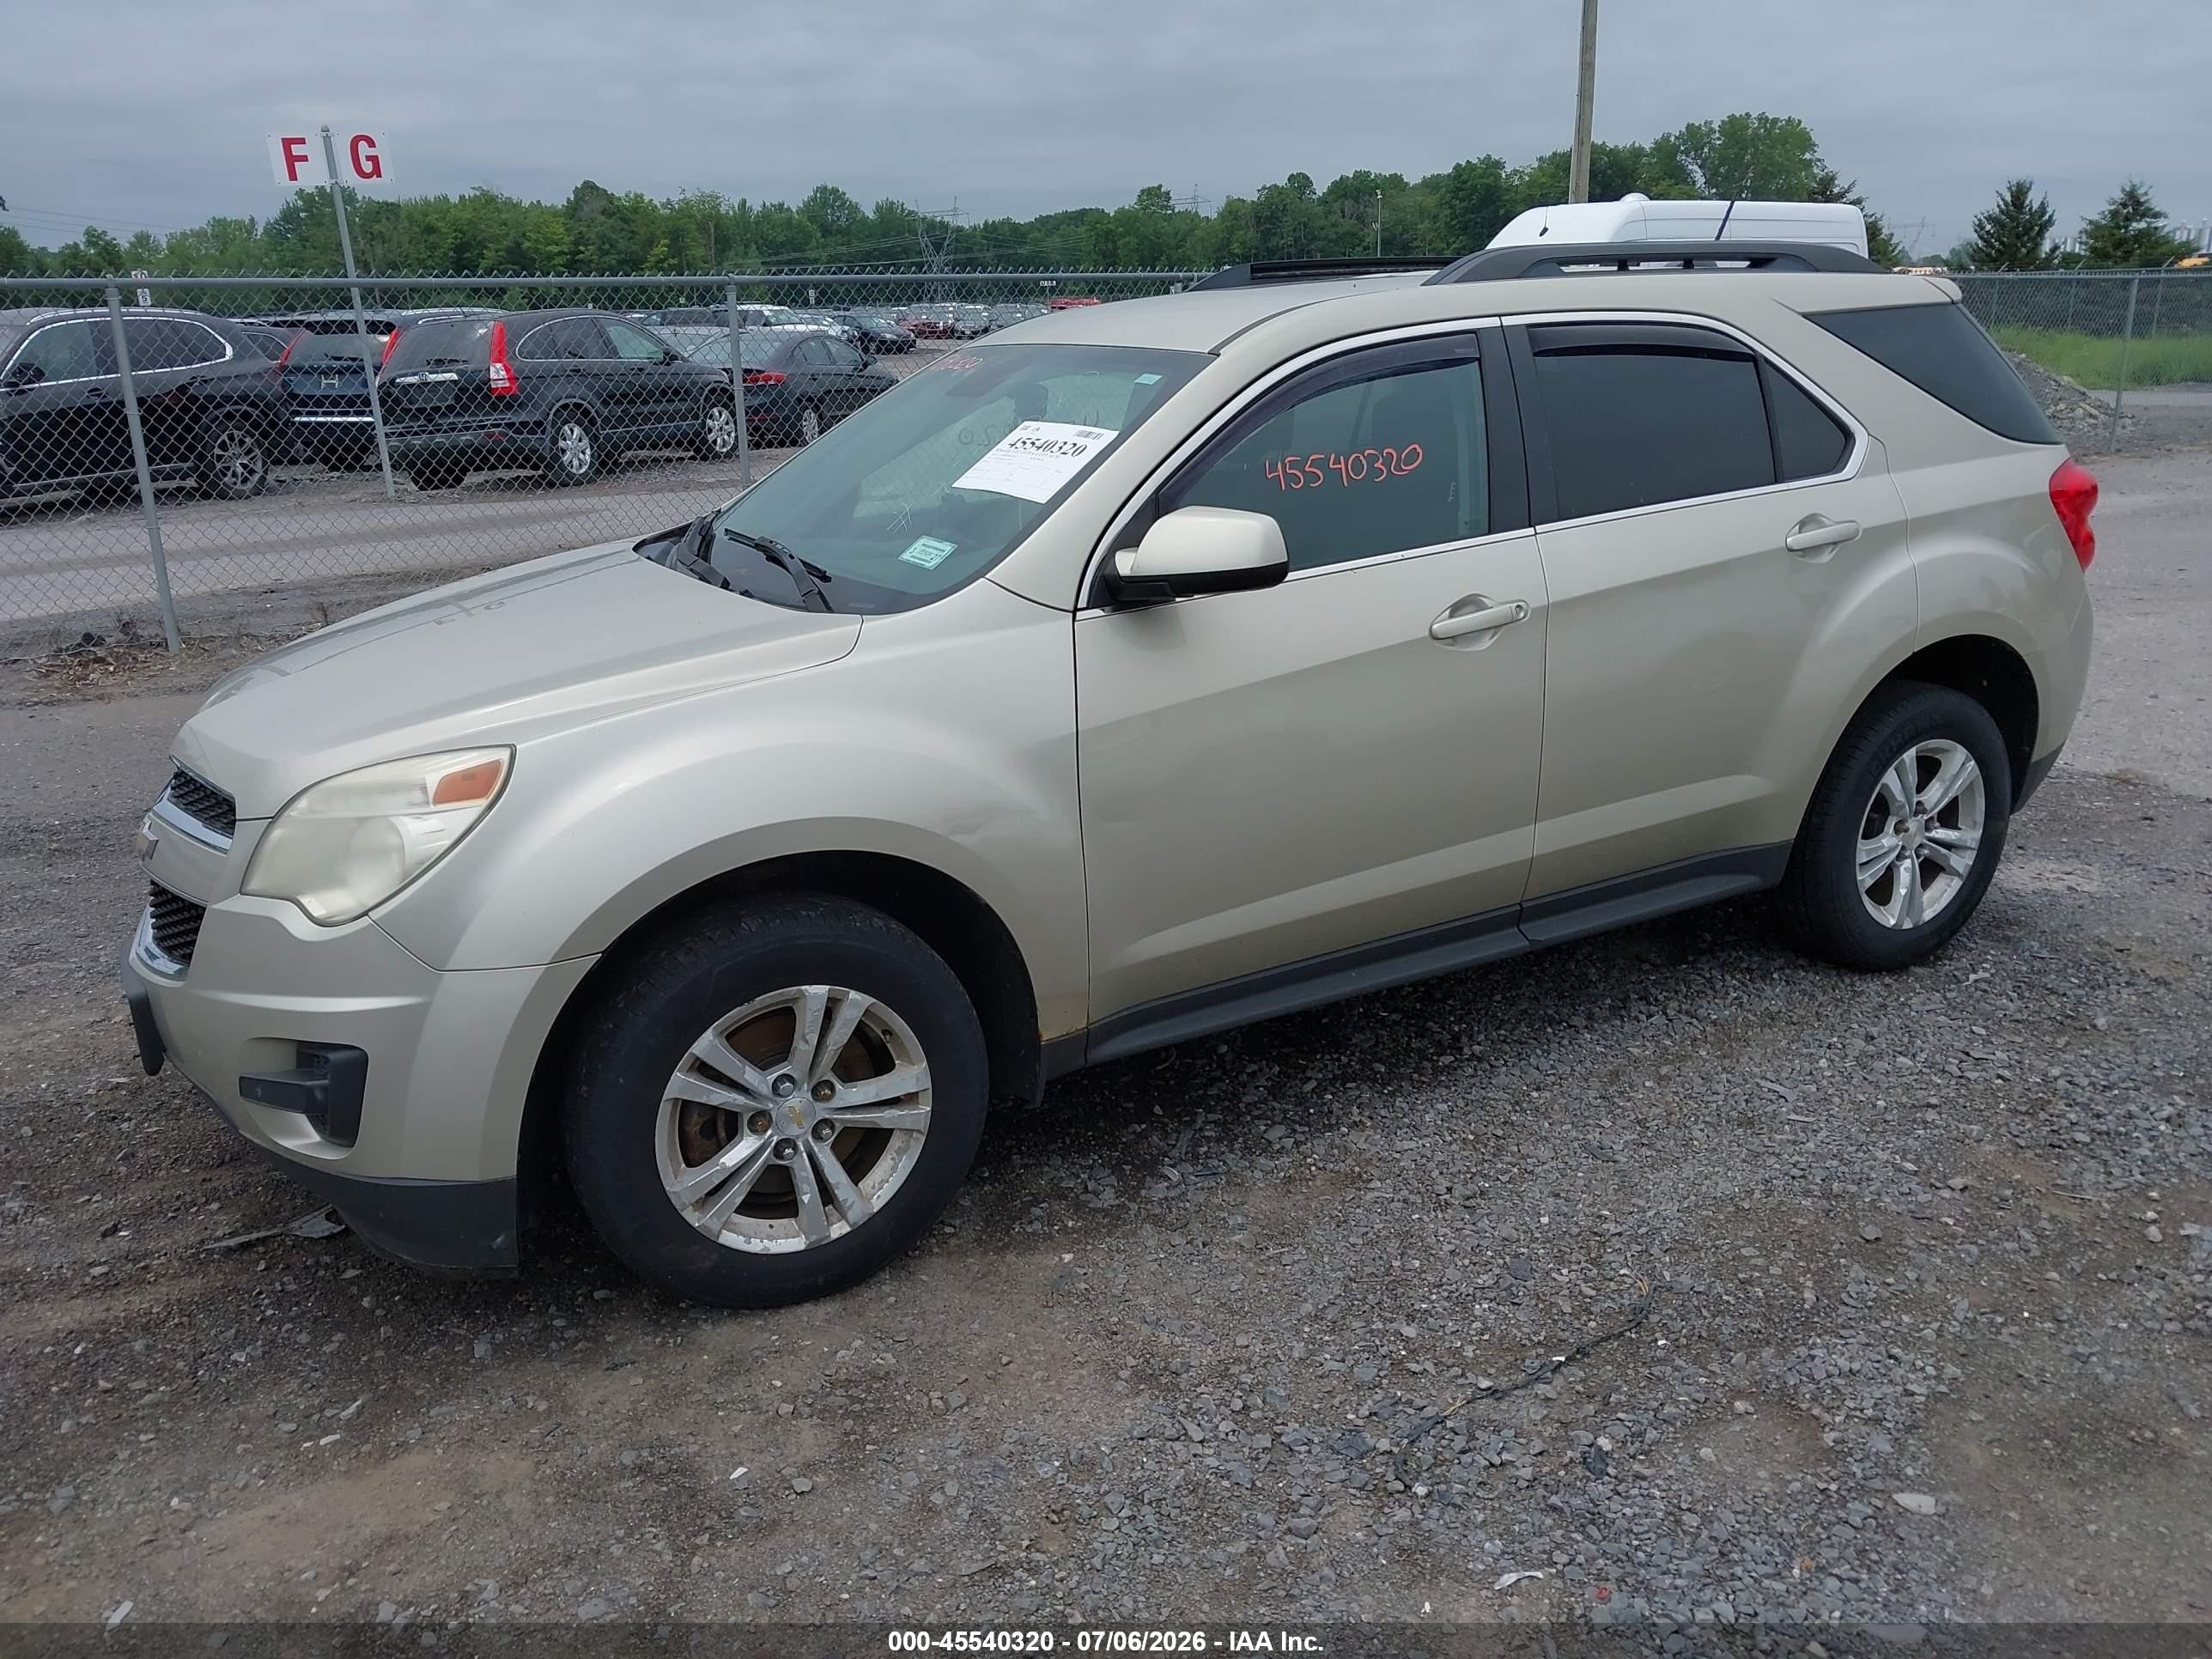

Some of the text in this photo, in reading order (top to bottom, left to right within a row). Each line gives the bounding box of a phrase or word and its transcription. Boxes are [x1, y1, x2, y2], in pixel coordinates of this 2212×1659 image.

[281, 137, 308, 181] F
[349, 134, 383, 179] G
[1008, 436, 1088, 458] 45540320
[1266, 443, 1423, 490] 45540320
